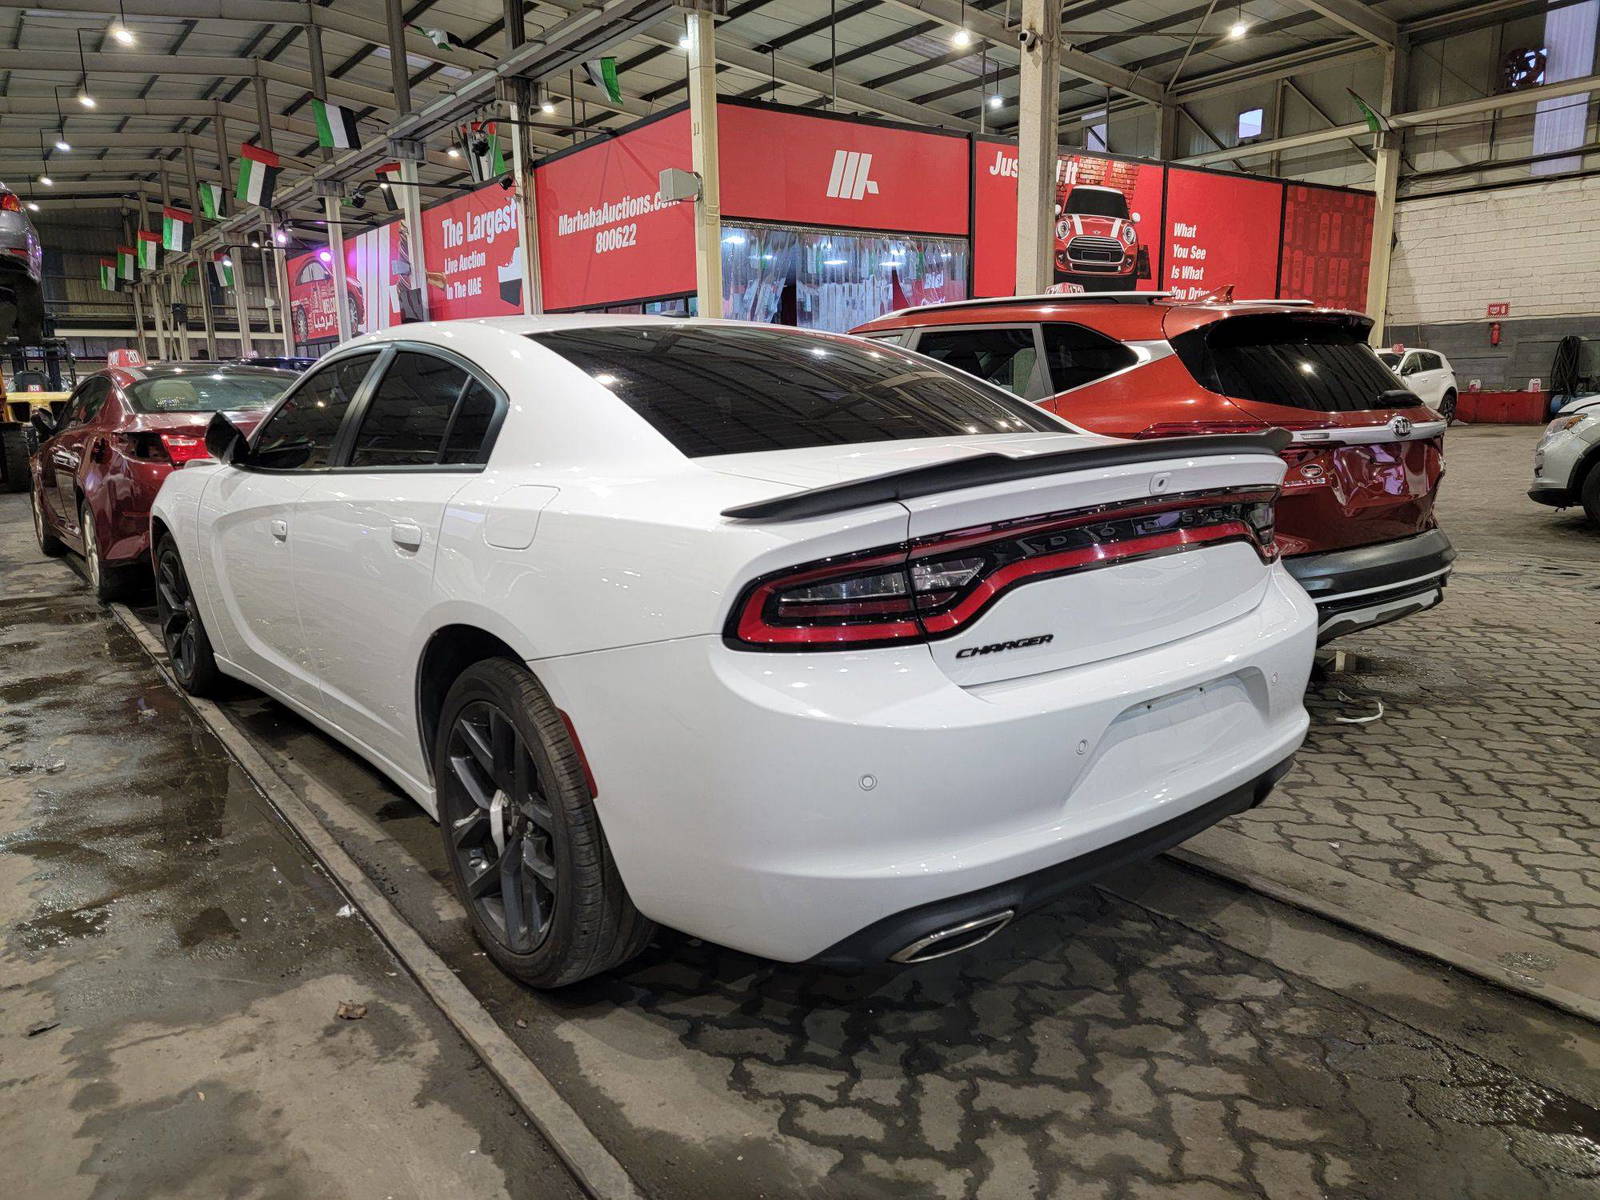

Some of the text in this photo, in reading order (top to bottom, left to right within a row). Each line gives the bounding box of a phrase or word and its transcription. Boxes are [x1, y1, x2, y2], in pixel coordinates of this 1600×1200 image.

[990, 151, 1019, 178] Jus
[442, 198, 517, 249] The Largest
[558, 191, 681, 236] MarhabaAuctions.c
[595, 223, 637, 253] 800622
[1174, 222, 1197, 238] What
[444, 250, 486, 275] Live Auction
[1173, 243, 1206, 260] You See
[1171, 265, 1204, 280] Is What
[446, 277, 482, 300] In The UAE
[1171, 285, 1187, 300] You
[956, 633, 1054, 659] CHARGER
